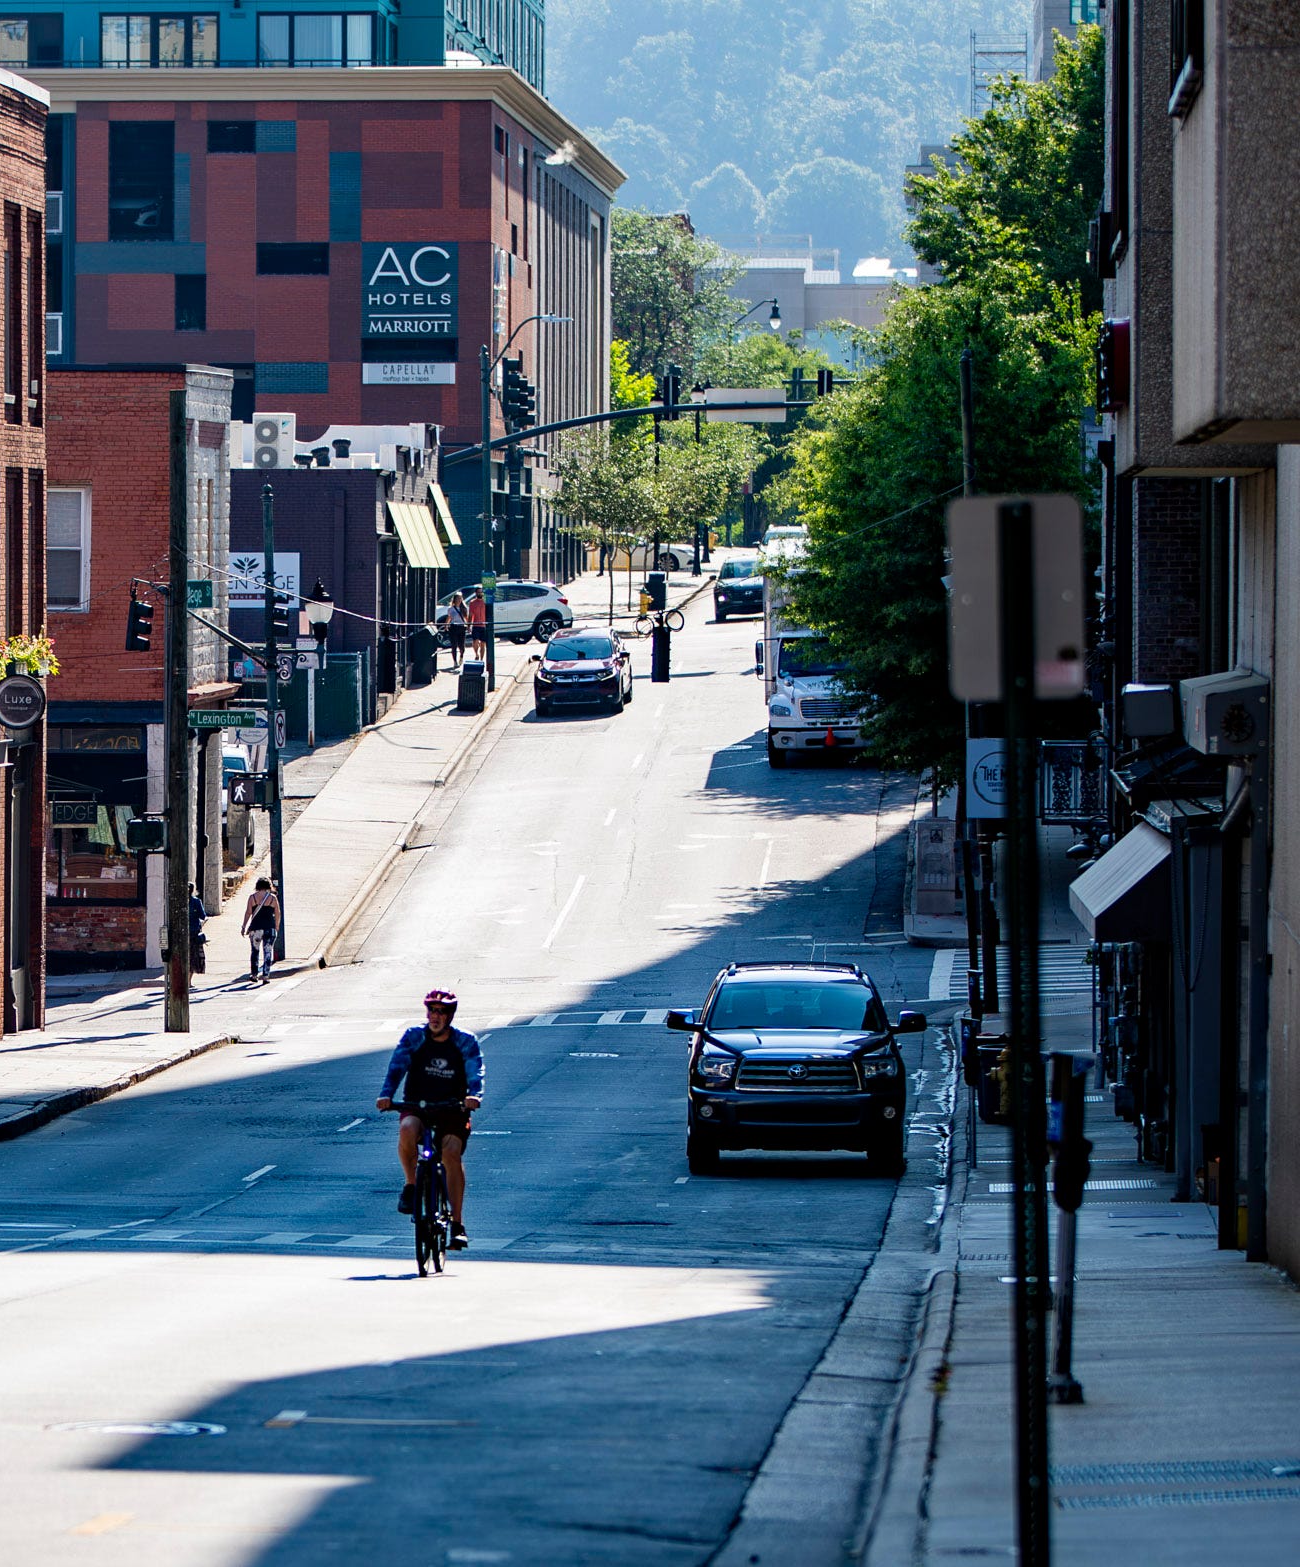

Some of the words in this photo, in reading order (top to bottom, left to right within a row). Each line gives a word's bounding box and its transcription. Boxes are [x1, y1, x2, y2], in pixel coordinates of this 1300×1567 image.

[368, 246, 451, 286] AC
[368, 293, 451, 305] HOTELS
[368, 320, 451, 333] MARRIOTT
[254, 575, 295, 590] SGE
[4, 693, 32, 704] Luxe
[197, 712, 242, 725] Lexington
[979, 766, 998, 781] THE
[55, 805, 94, 821] EDGE
